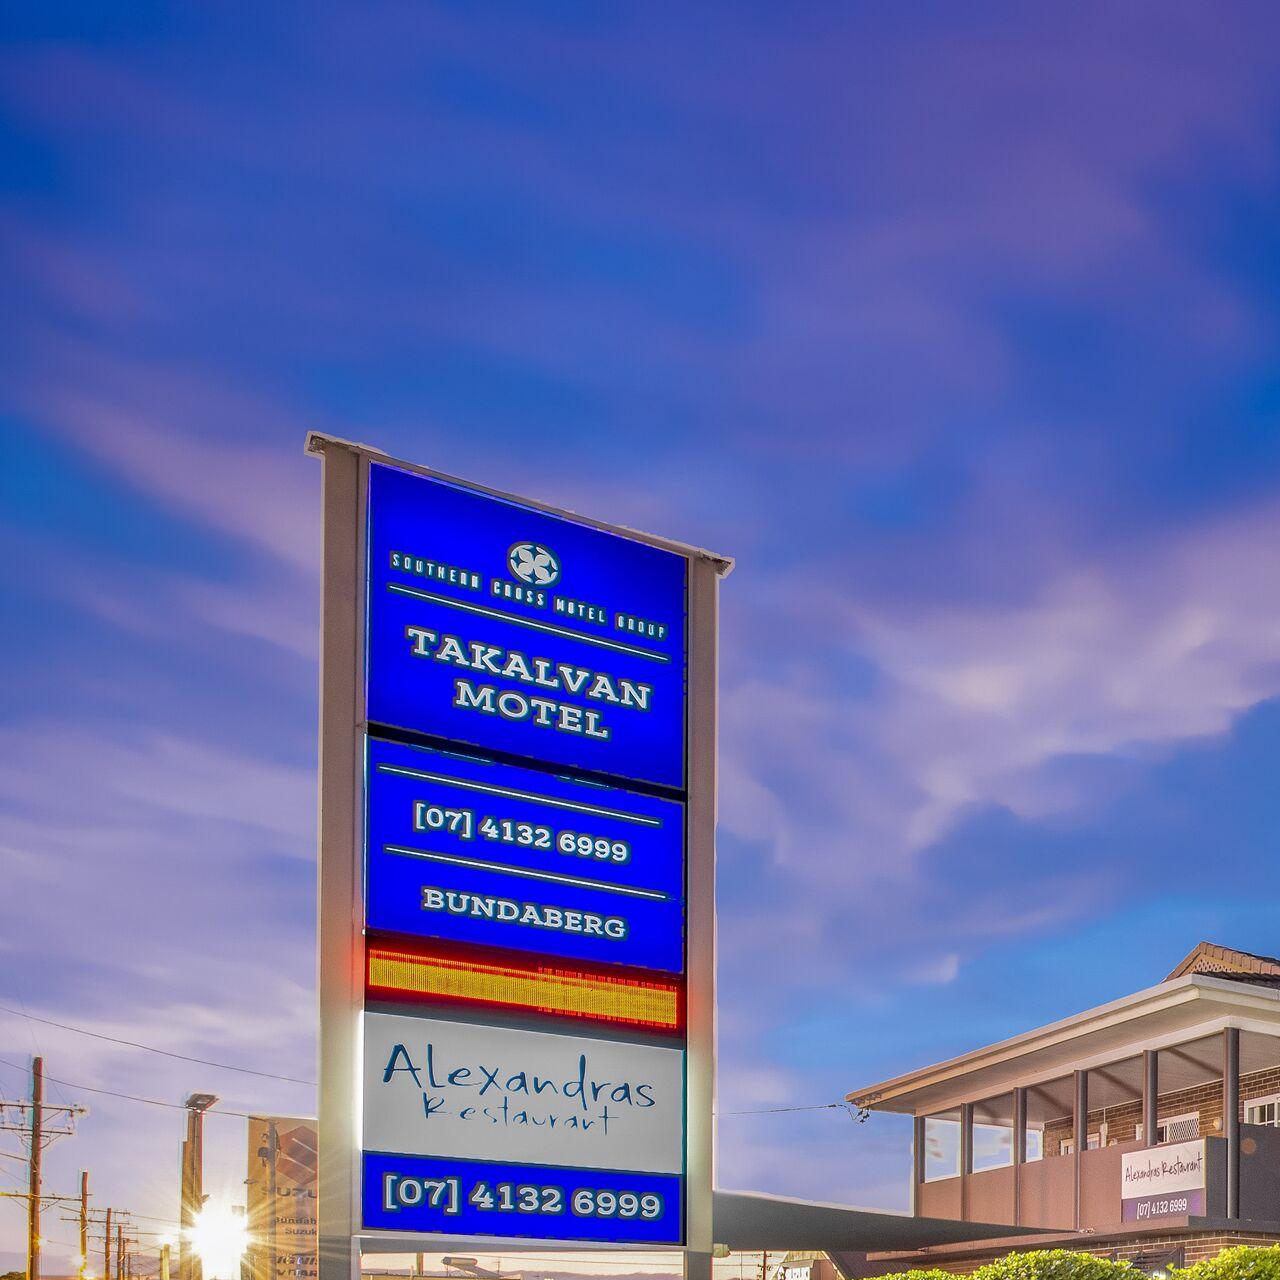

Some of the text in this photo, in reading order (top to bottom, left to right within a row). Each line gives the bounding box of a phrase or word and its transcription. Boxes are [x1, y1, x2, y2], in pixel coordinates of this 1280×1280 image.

[391, 553, 665, 638] SOUTHERN CROSS MOTEL GROUP
[407, 628, 651, 709] TAKALVAN
[455, 681, 609, 738] MOTEL
[415, 803, 628, 862] [07] 4132 6999
[424, 889, 626, 937] BUNDABERG
[383, 1044, 656, 1110] Alexandras
[1125, 1152, 1203, 1182] Alexandras Restaurant
[385, 1175, 660, 1217] [07] 4132 6999
[1136, 1198, 1187, 1219] [07] 4132 6999
